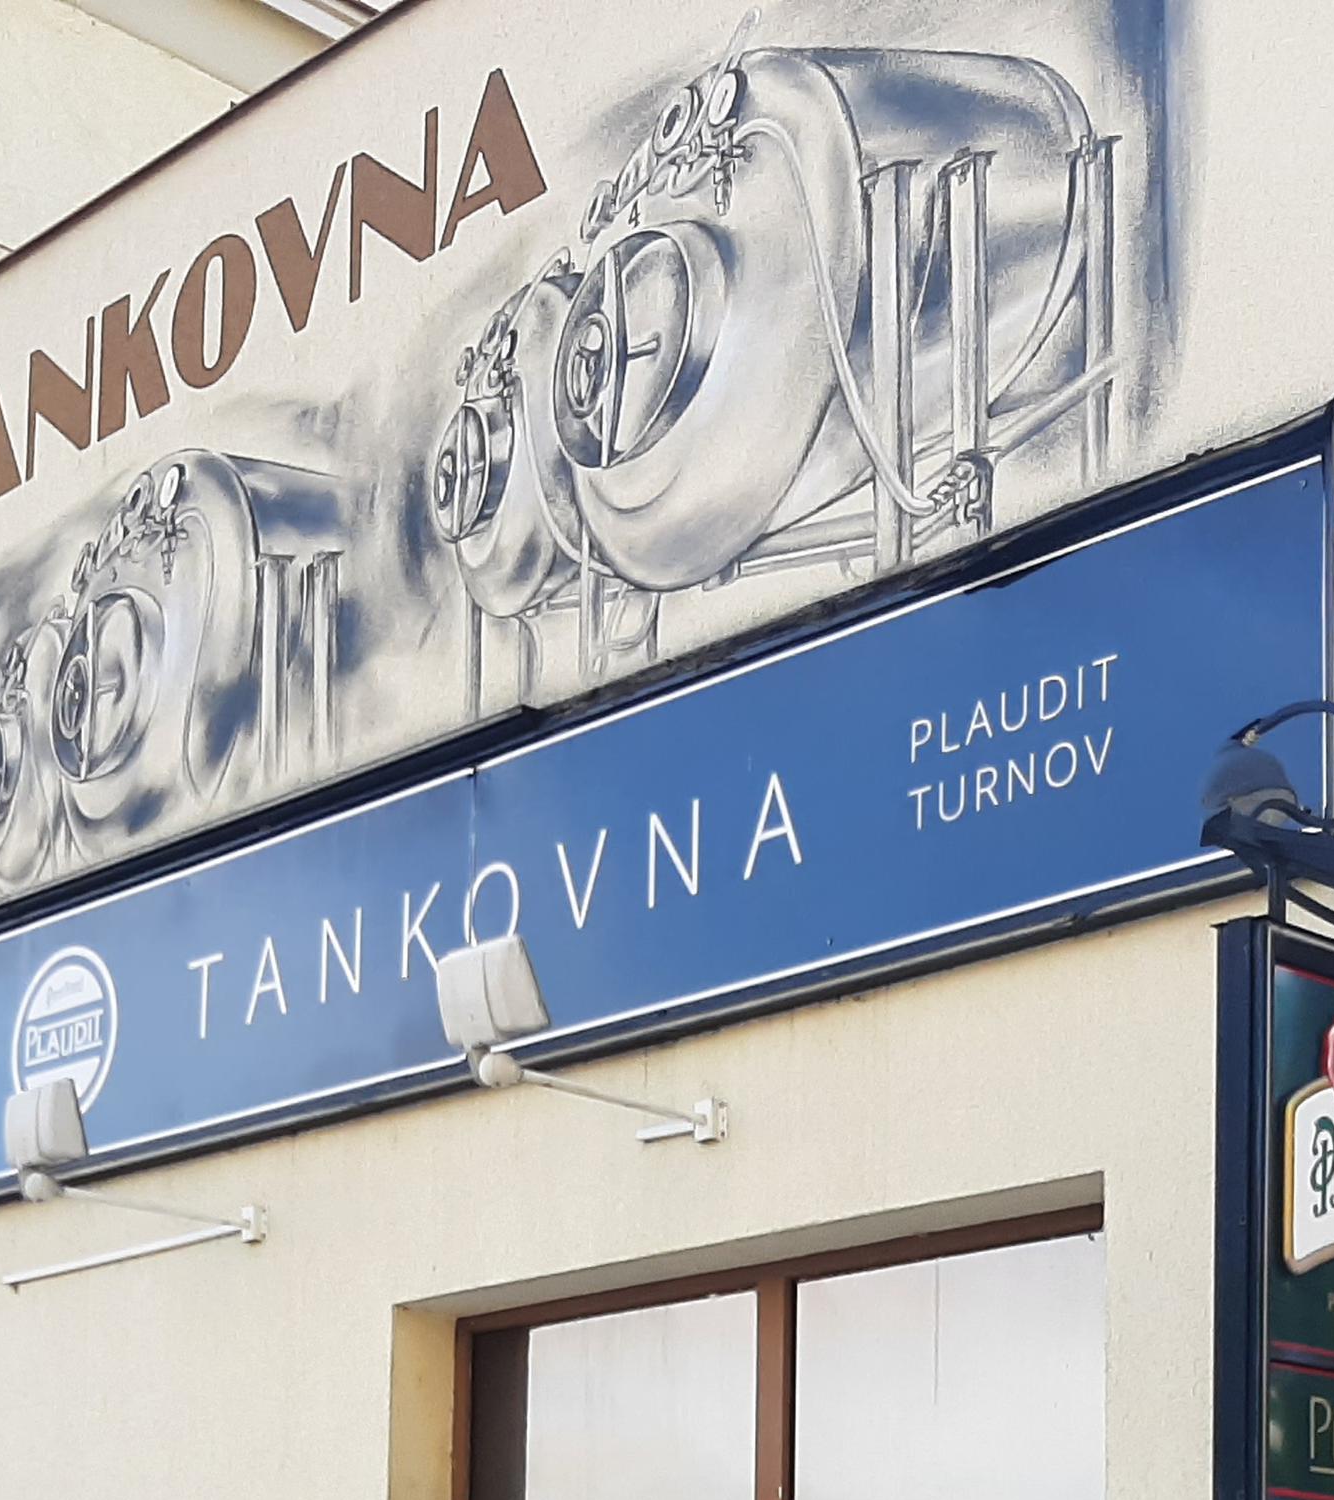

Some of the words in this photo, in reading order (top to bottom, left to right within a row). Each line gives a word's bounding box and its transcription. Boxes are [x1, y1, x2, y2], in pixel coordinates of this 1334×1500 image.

[909, 654, 1118, 763] PLAUDIT
[908, 727, 1115, 830] TURNOV
[188, 769, 803, 1040] TANKOVNA
[25, 1008, 105, 1067] PLAUDIT
